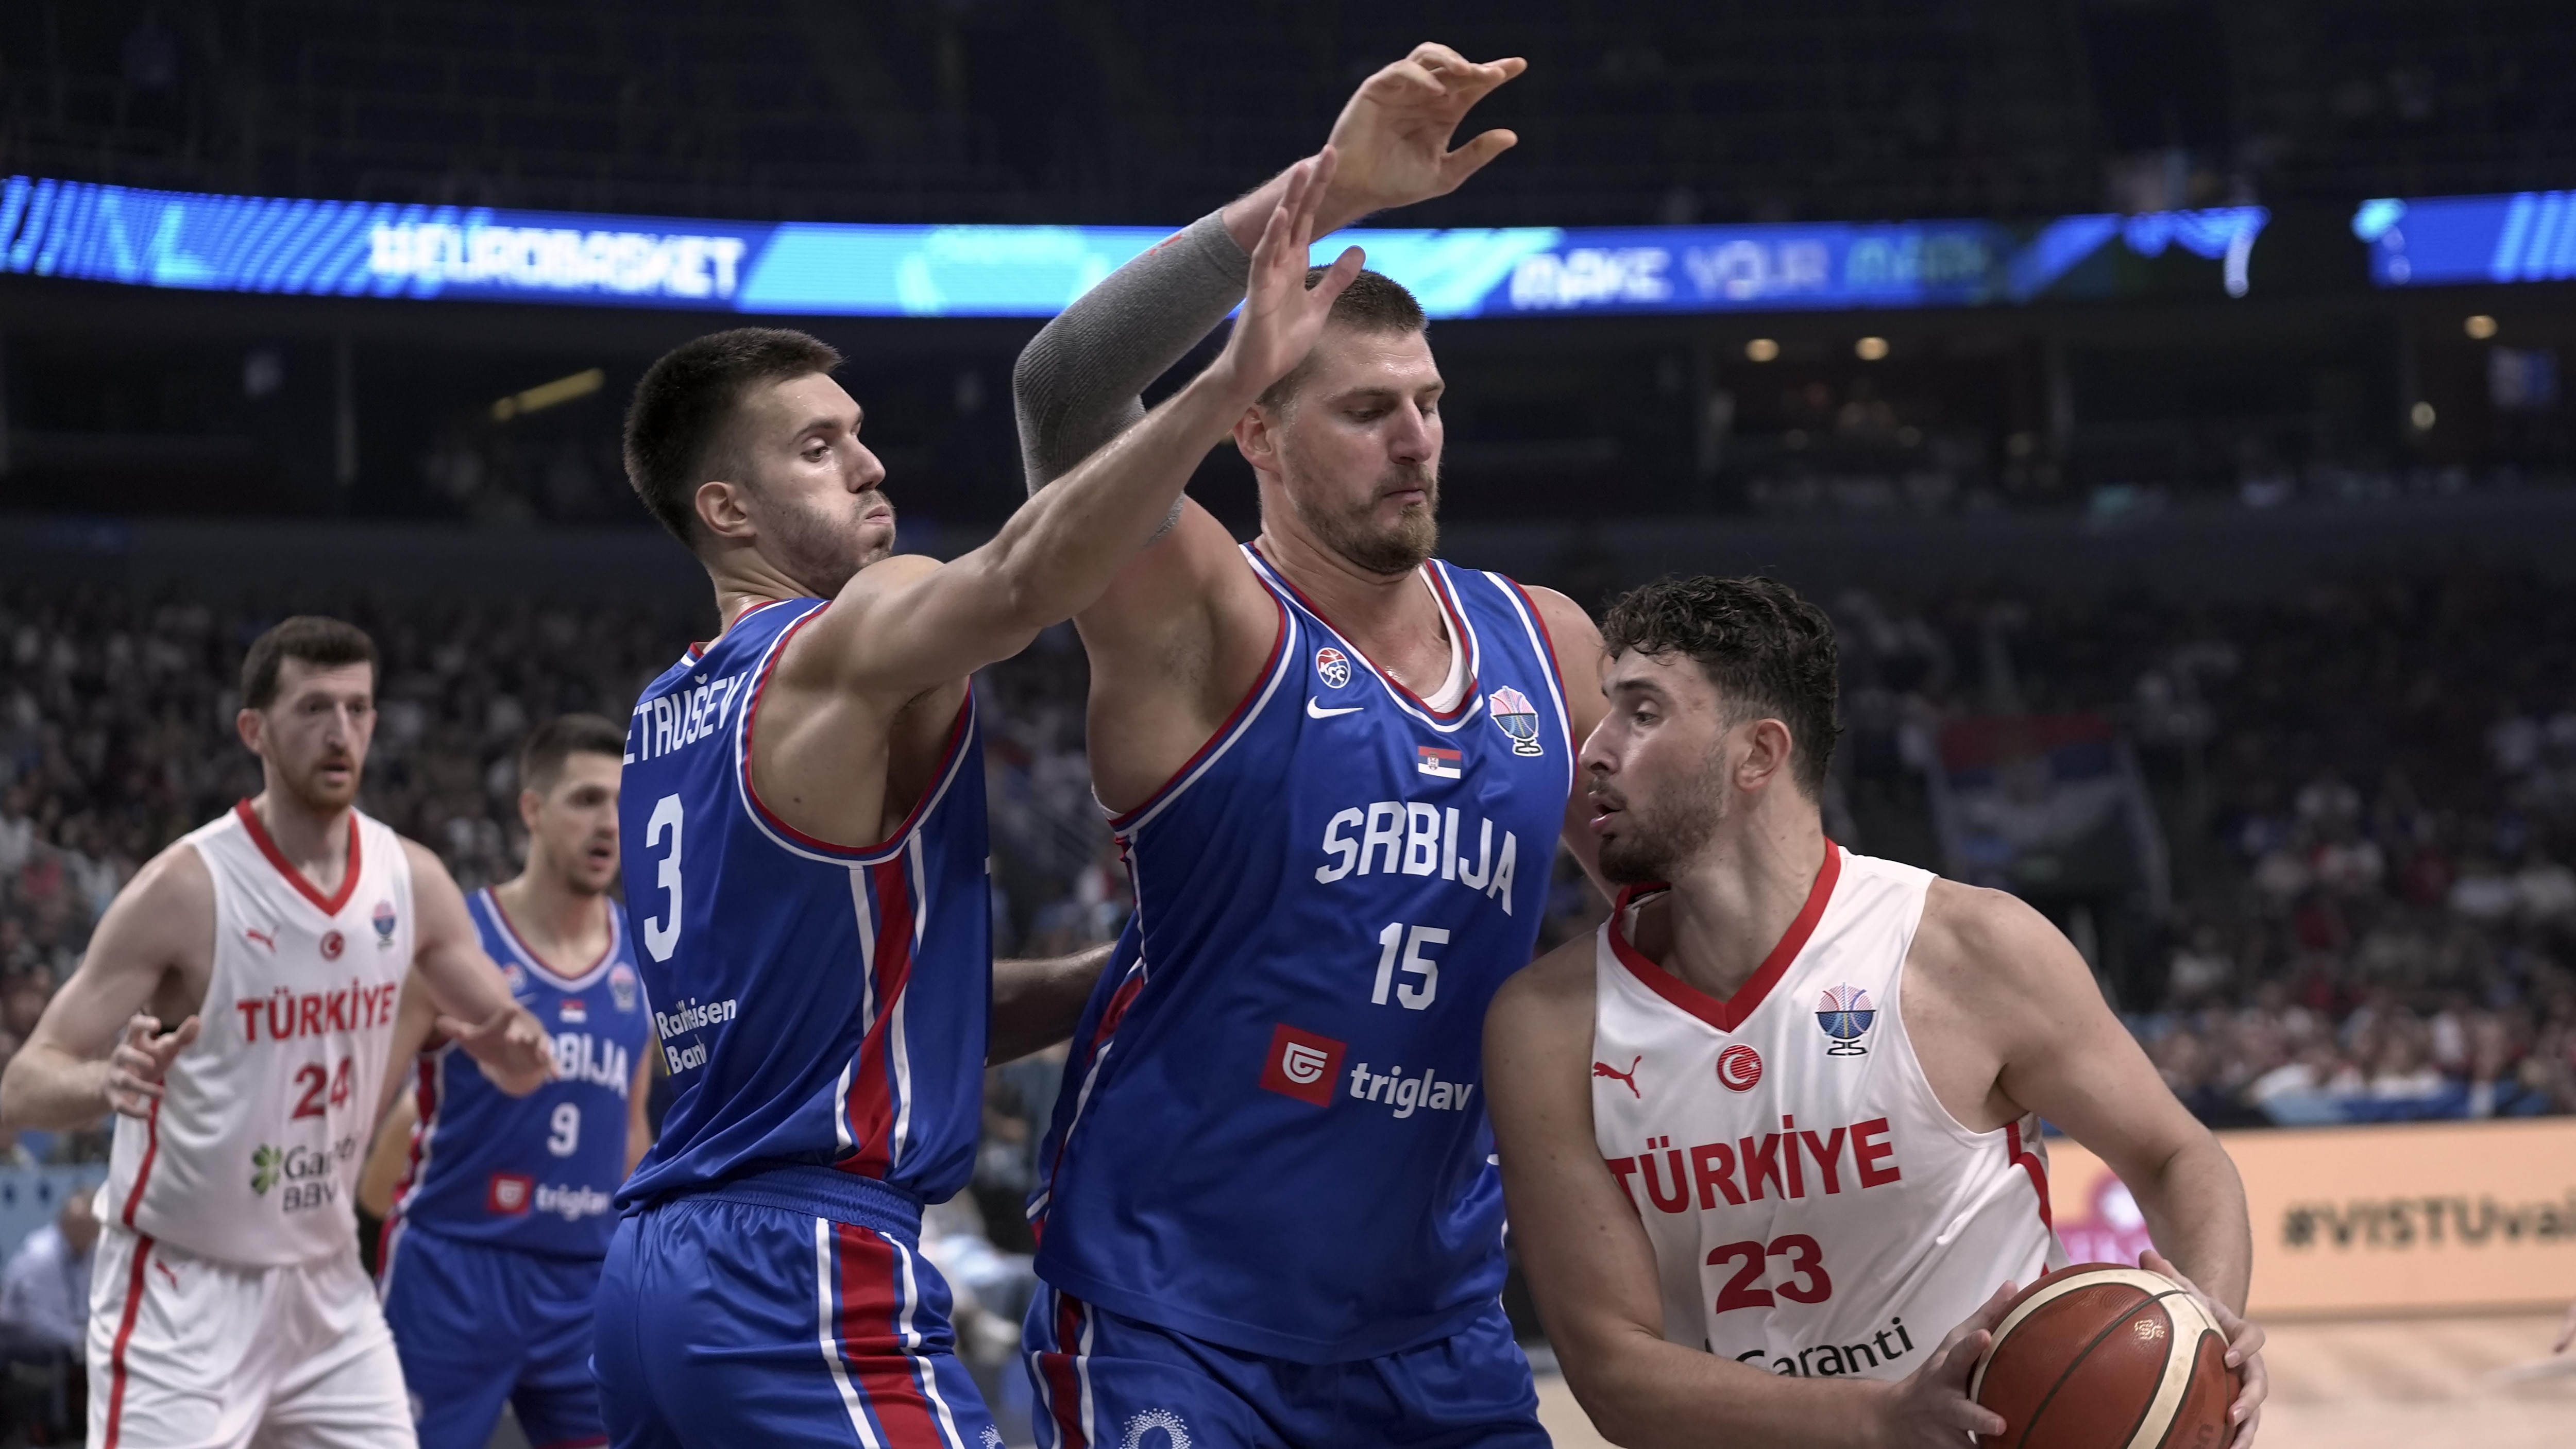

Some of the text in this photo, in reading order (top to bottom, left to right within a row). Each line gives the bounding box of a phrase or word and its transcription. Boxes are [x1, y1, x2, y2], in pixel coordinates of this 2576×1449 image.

[622, 672, 748, 765] ETRUŠEV
[644, 793, 684, 963] 3
[1315, 801, 1516, 916] SRBIJA
[1371, 922, 1450, 1010] 15
[237, 977, 396, 1043] TÜRKİYE
[291, 1056, 351, 1119] 24
[547, 1032, 629, 1100] BIJA
[1349, 1063, 1473, 1118] triglav
[547, 1102, 581, 1157] 9
[1606, 1114, 1901, 1216] TÜRKİYE
[283, 1179, 338, 1212] BBV
[1706, 1234, 1832, 1315] 23
